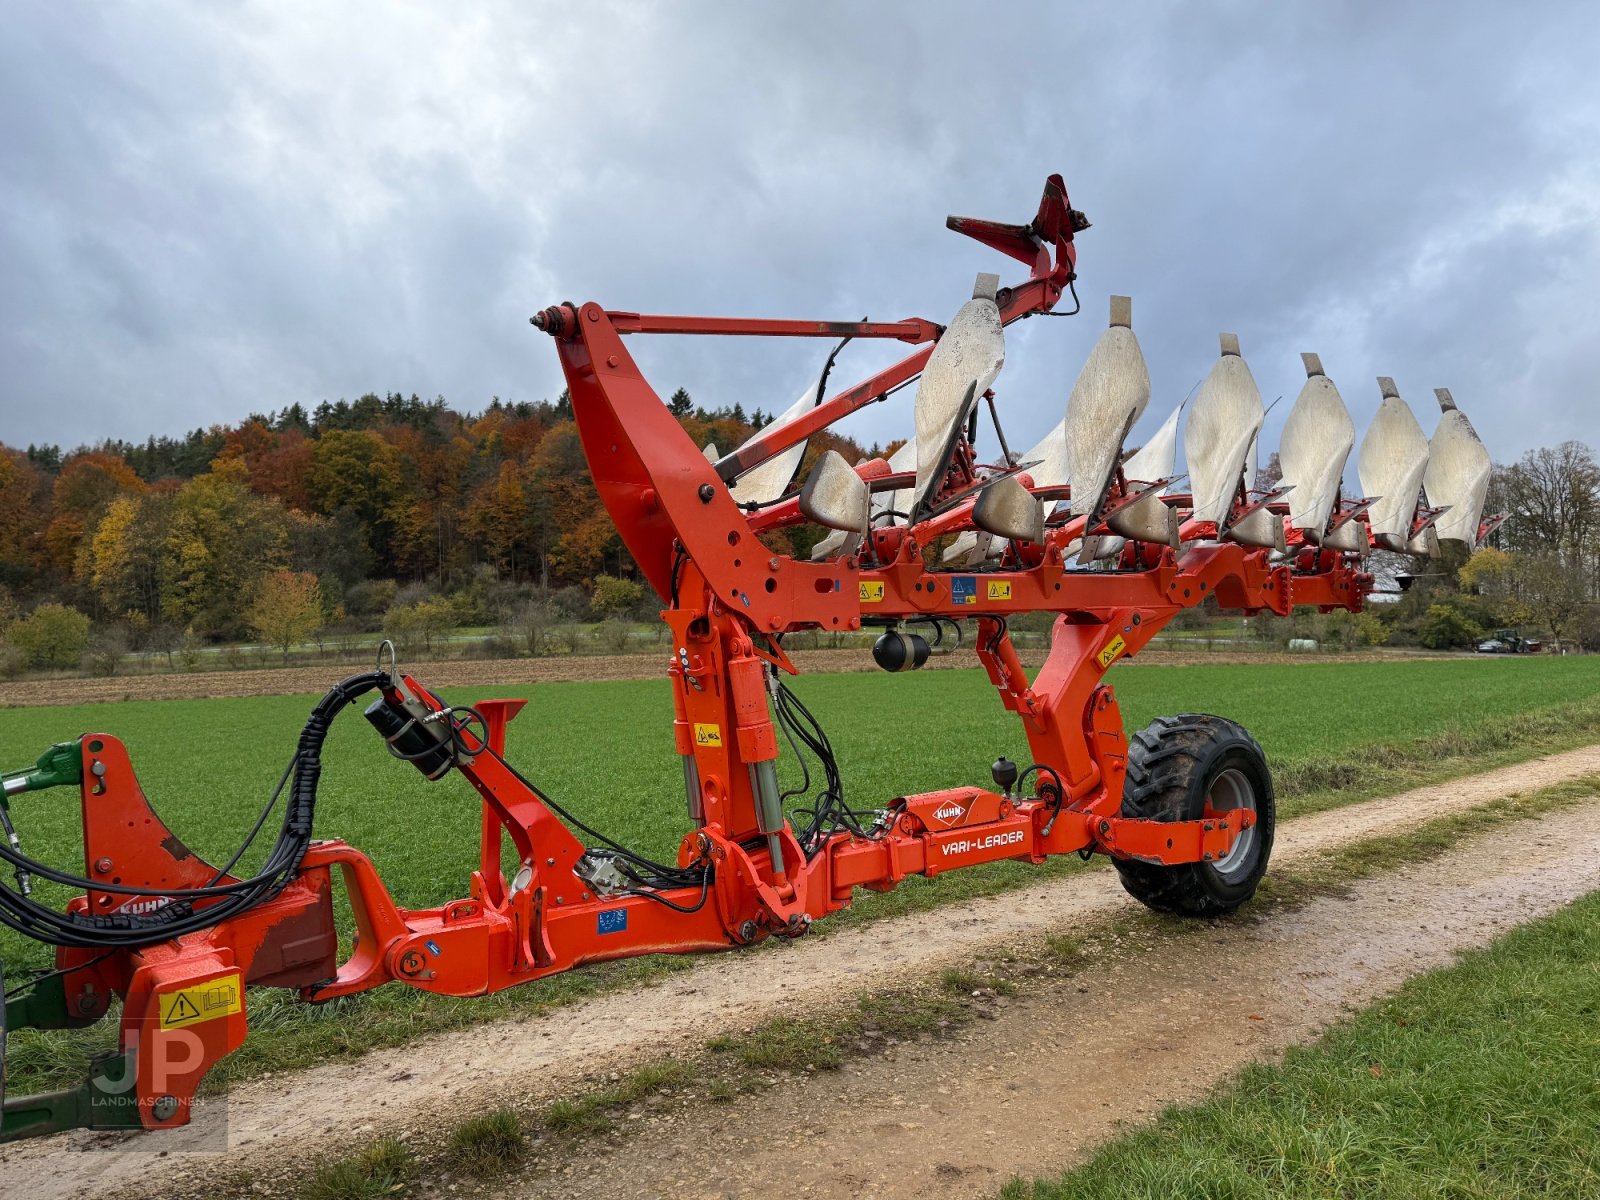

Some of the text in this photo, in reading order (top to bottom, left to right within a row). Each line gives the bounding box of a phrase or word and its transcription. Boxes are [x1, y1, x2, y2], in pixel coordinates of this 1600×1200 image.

[937, 806, 961, 819] KUHN
[942, 831, 1024, 855] VARI-LEADER
[120, 897, 169, 914] KUHN
